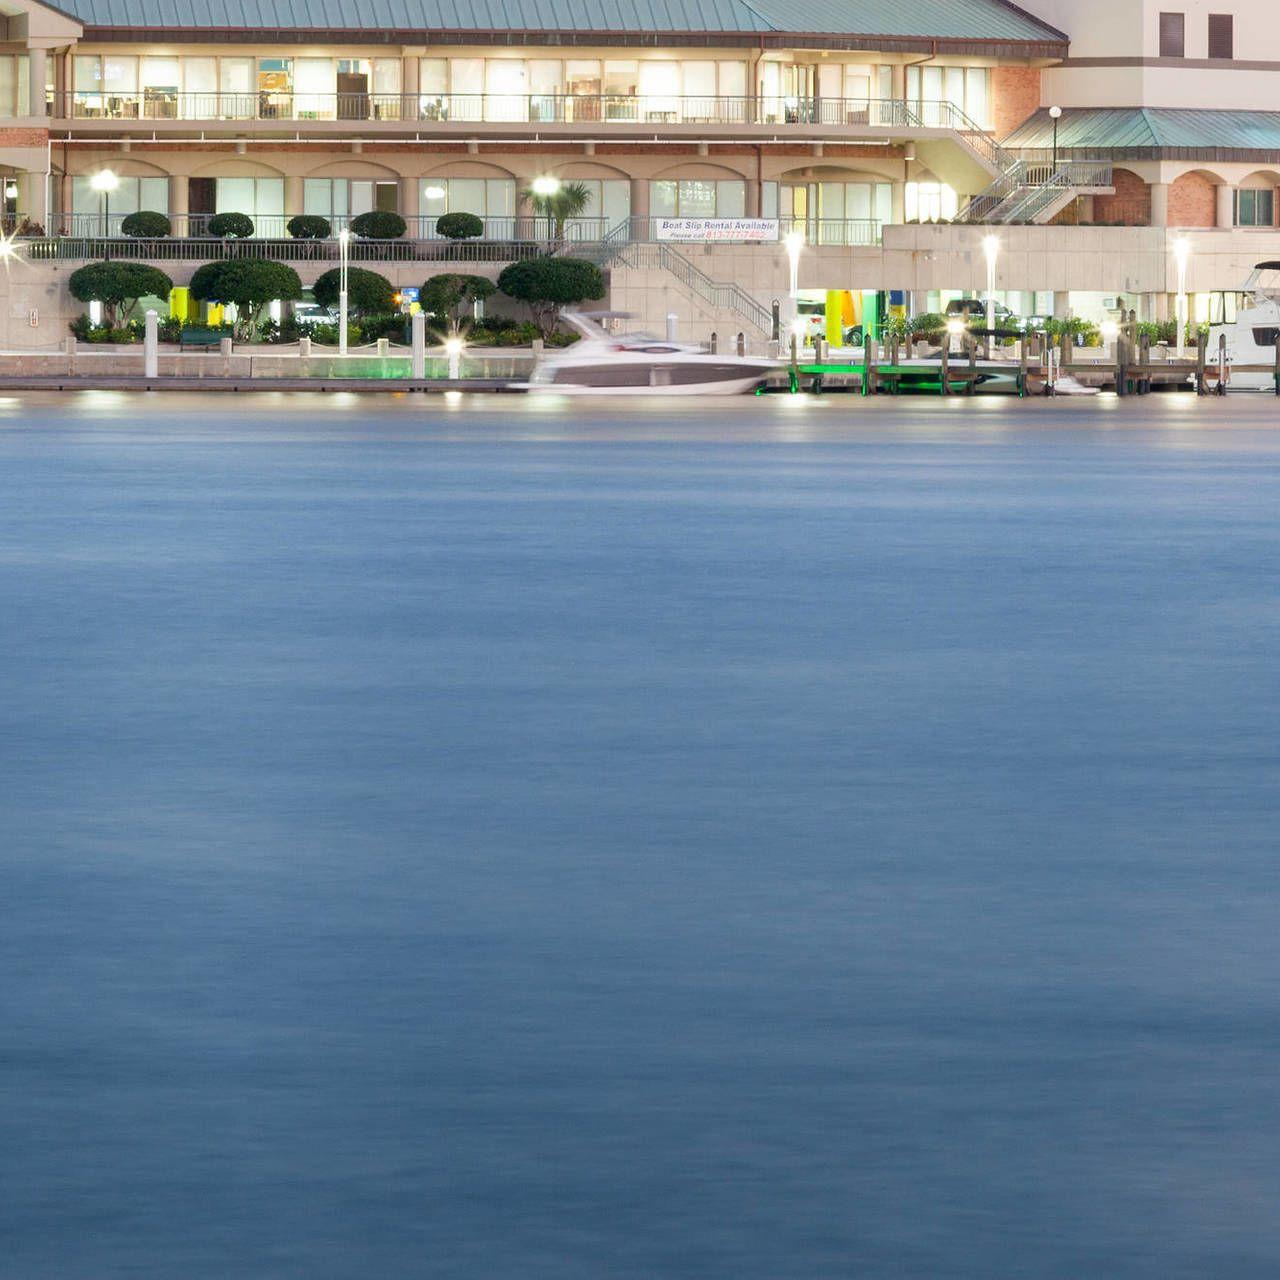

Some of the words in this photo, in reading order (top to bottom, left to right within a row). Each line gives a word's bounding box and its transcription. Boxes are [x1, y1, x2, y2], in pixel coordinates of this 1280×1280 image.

[662, 221, 682, 229] Boat
[685, 221, 702, 230] Slip
[704, 221, 733, 229] Rental
[735, 221, 775, 229] Available
